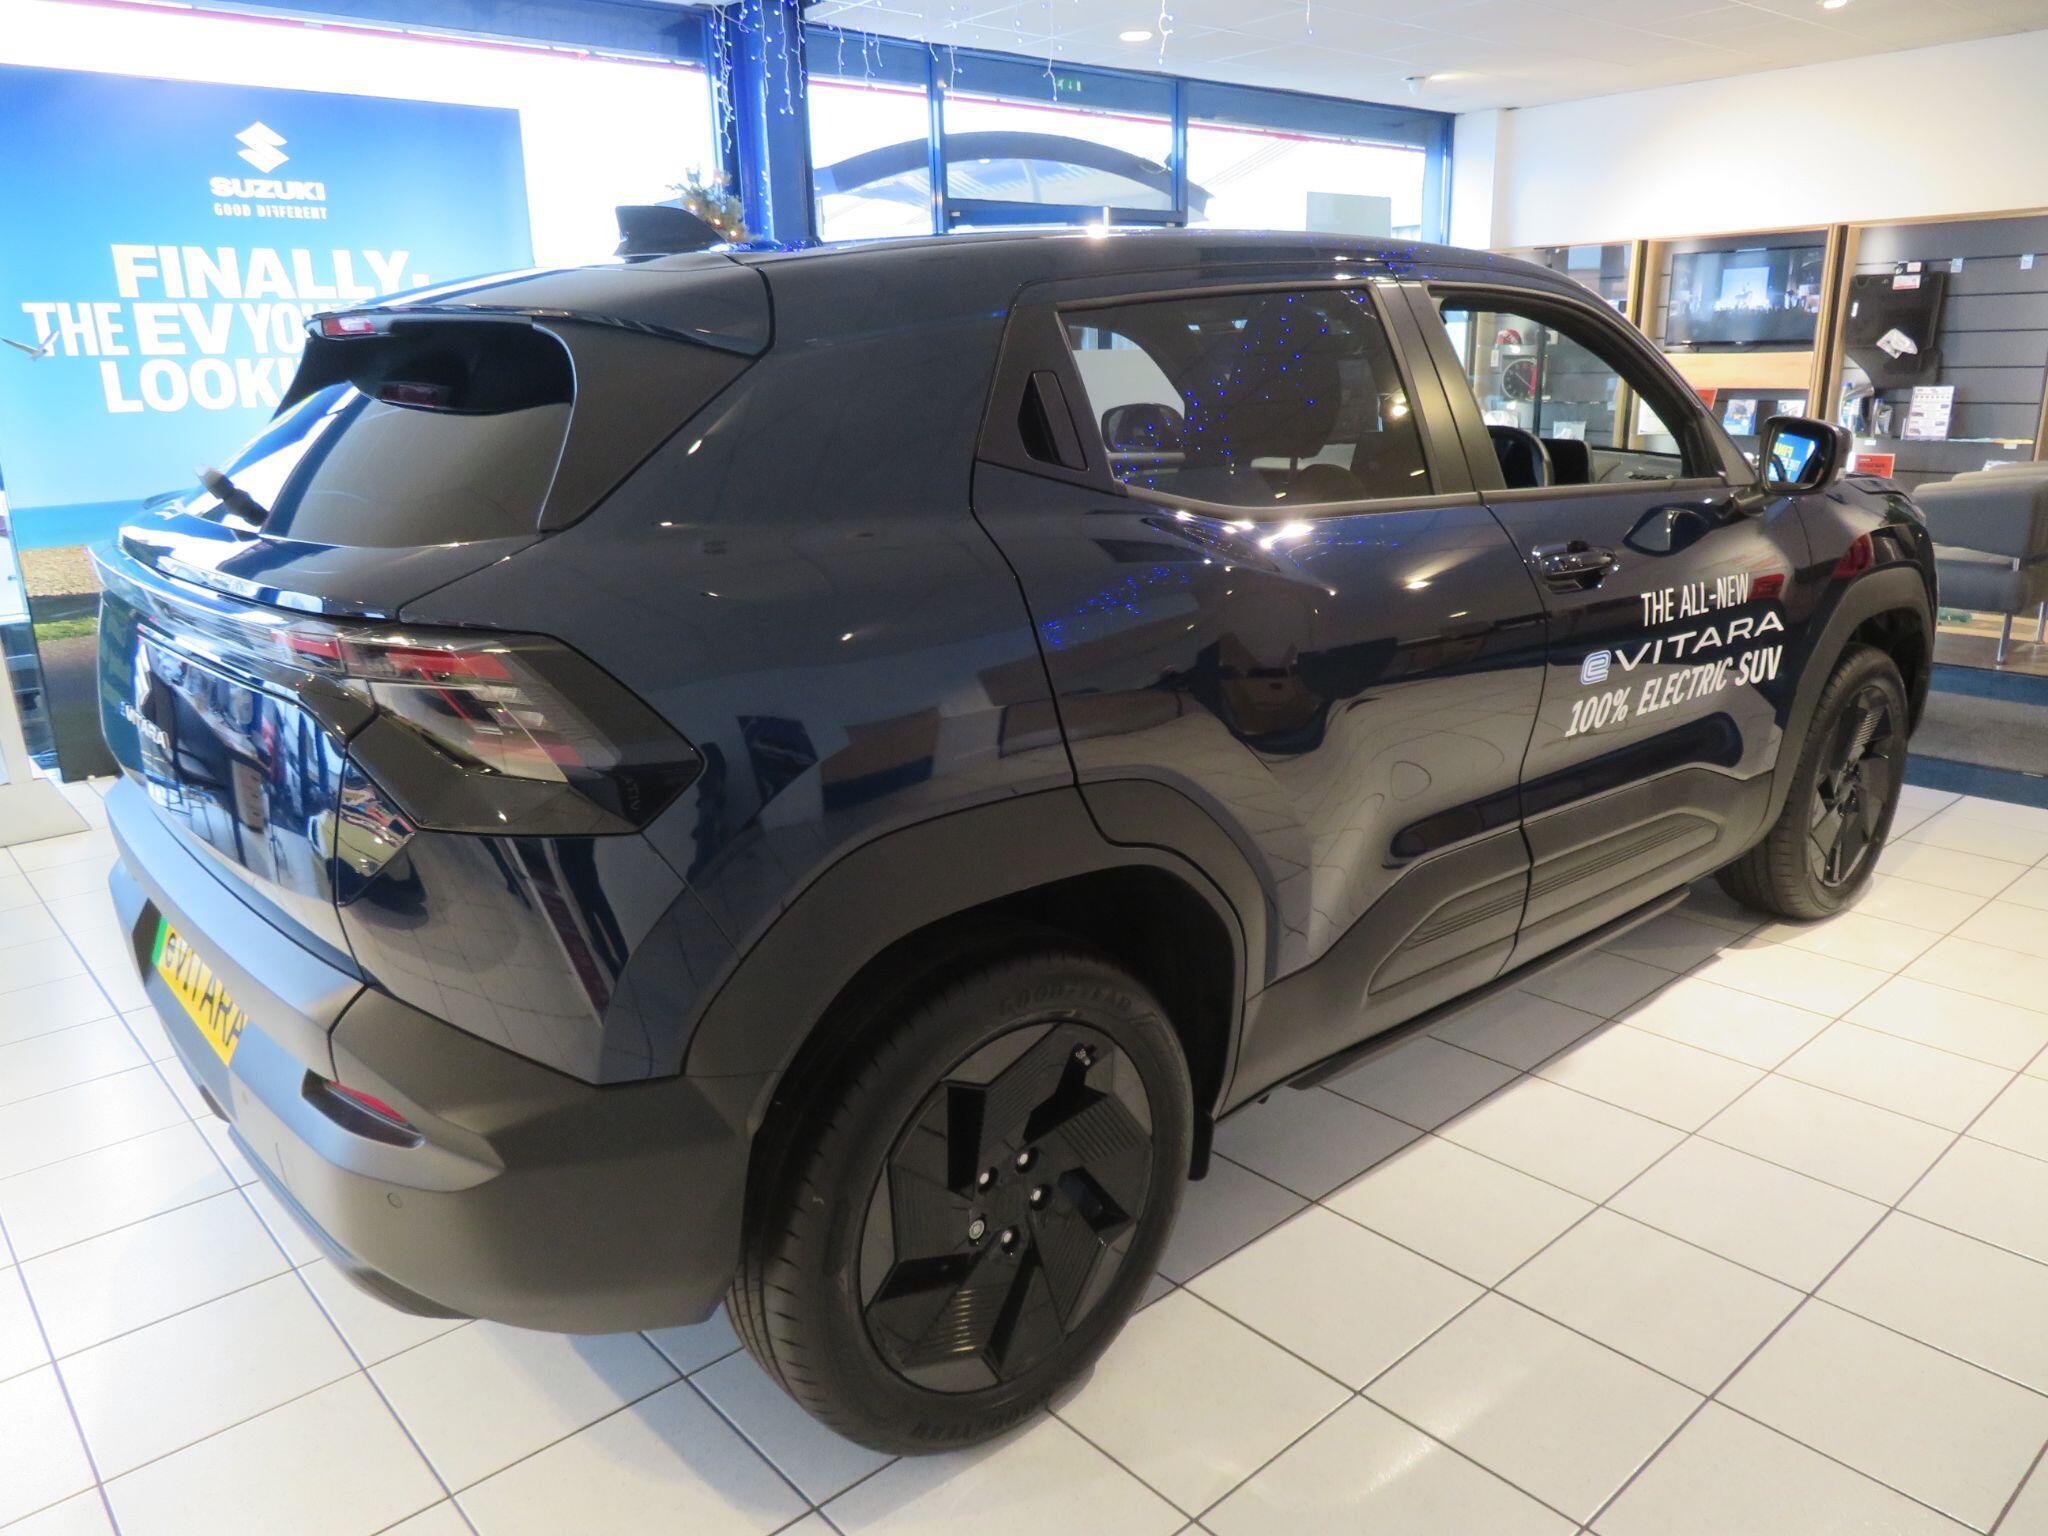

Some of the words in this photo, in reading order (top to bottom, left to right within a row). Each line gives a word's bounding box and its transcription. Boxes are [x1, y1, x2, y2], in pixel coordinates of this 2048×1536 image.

[209, 176, 326, 201] SUZUKI
[213, 202, 252, 217] GOOD
[256, 204, 327, 219] DIFFERENT
[22, 302, 130, 357] THE
[132, 302, 233, 356] EV
[1641, 587, 1674, 627] THE
[1679, 572, 1749, 619] ALL-NEW
[1564, 688, 1632, 738] 100%
[1636, 656, 1733, 717] ELECTRIC
[1735, 645, 1783, 687] SUV
